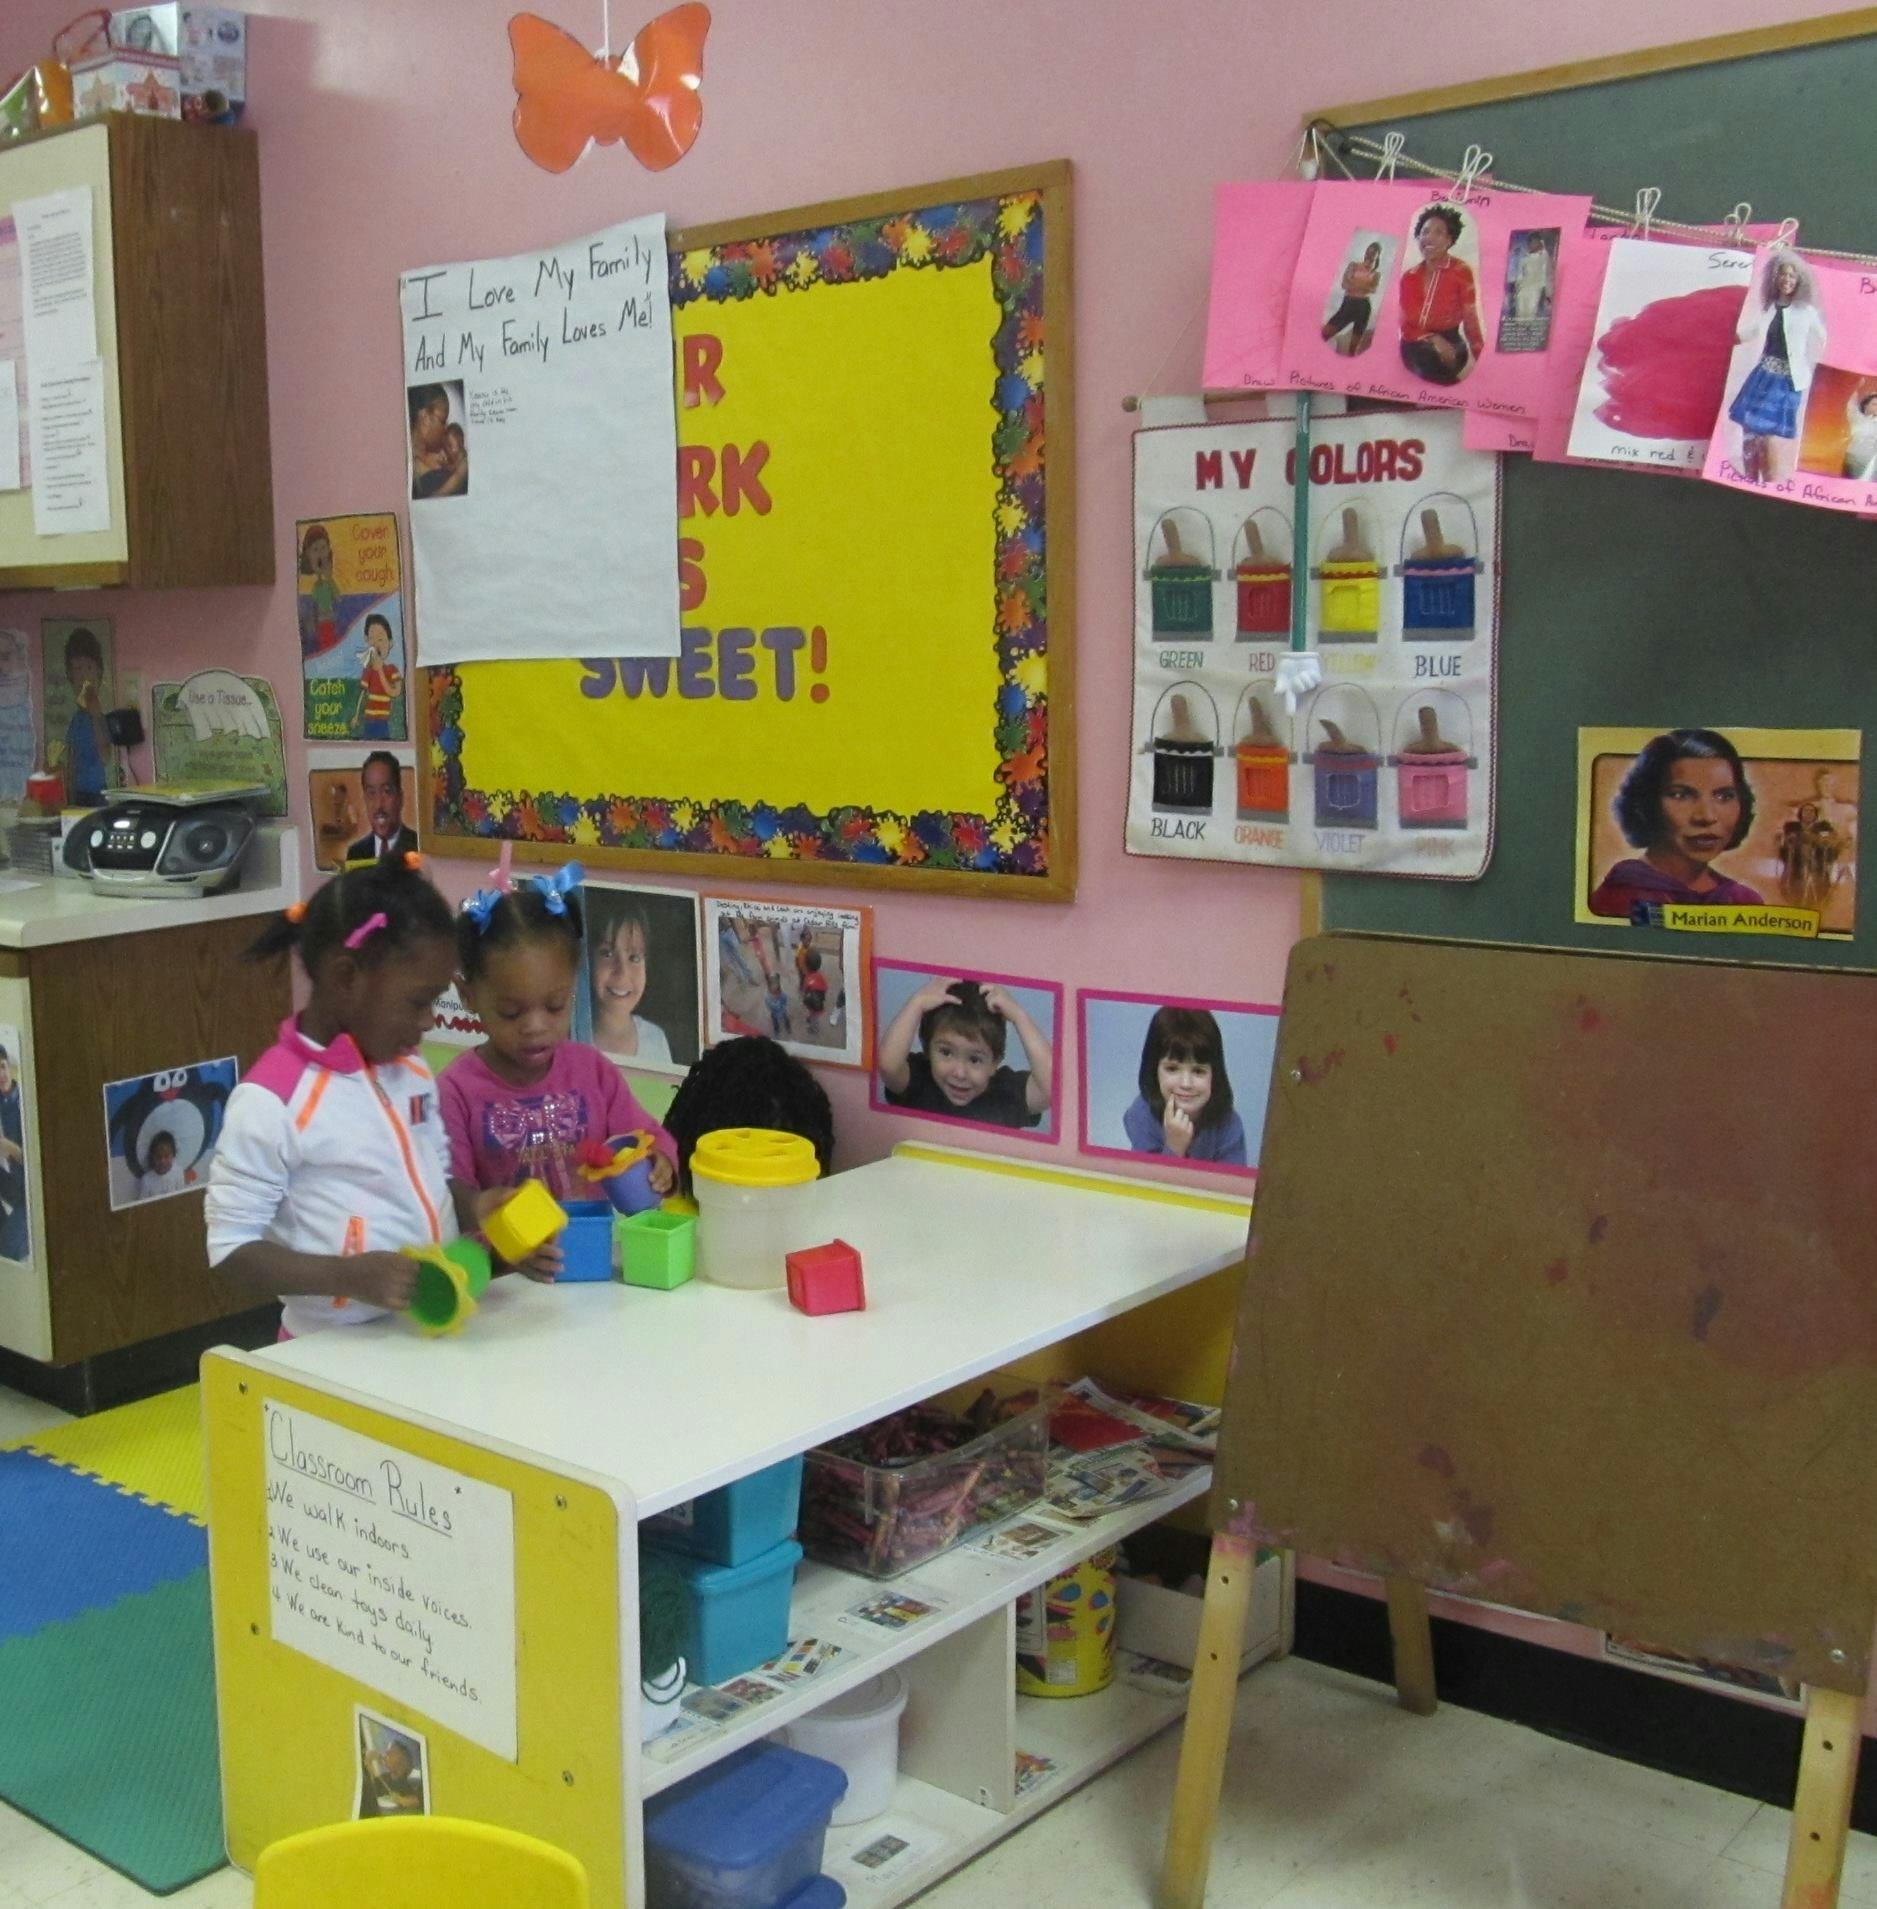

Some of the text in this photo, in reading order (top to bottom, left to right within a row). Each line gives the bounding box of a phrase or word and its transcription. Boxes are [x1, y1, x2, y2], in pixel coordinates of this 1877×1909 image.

[409, 234, 652, 321] I Love My Family
[414, 333, 446, 372] And
[457, 331, 485, 372] My
[502, 319, 549, 363] Family
[562, 307, 607, 344] Loves
[683, 333, 727, 410] R
[1345, 381, 1363, 393] of
[1367, 384, 1411, 401] African
[1195, 447, 1258, 491] MY
[1610, 445, 1640, 458] mix
[1649, 447, 1676, 462] red
[677, 439, 773, 518] RK
[1776, 478, 1796, 494] of
[1802, 483, 1858, 506] African
[351, 524, 389, 541] Cover
[357, 546, 387, 563] your
[355, 564, 393, 587] cough
[578, 625, 830, 704] SWEET!
[1159, 651, 1204, 669] GREEN
[1249, 652, 1275, 672] RED
[1414, 654, 1462, 678] BLUE
[310, 680, 346, 697] Catch
[314, 703, 343, 720] your
[1151, 817, 1206, 840] BLACK
[1234, 825, 1284, 849] ORANGE
[1314, 830, 1365, 853] VIOLET
[1671, 911, 1812, 932] Marian Anderson
[270, 1410, 452, 1531] Classroom Rules
[269, 1480, 294, 1509] We
[304, 1503, 346, 1530] walk
[278, 1526, 300, 1552] We
[306, 1546, 329, 1566] use
[338, 1558, 361, 1577] our
[366, 1564, 415, 1602] inside
[282, 1557, 302, 1583] We
[309, 1574, 343, 1601] clean
[351, 1591, 388, 1627] toys
[395, 1614, 432, 1655] daily
[286, 1592, 305, 1616] We
[310, 1609, 331, 1629] are
[371, 1636, 387, 1656] to
[390, 1648, 414, 1668] our
